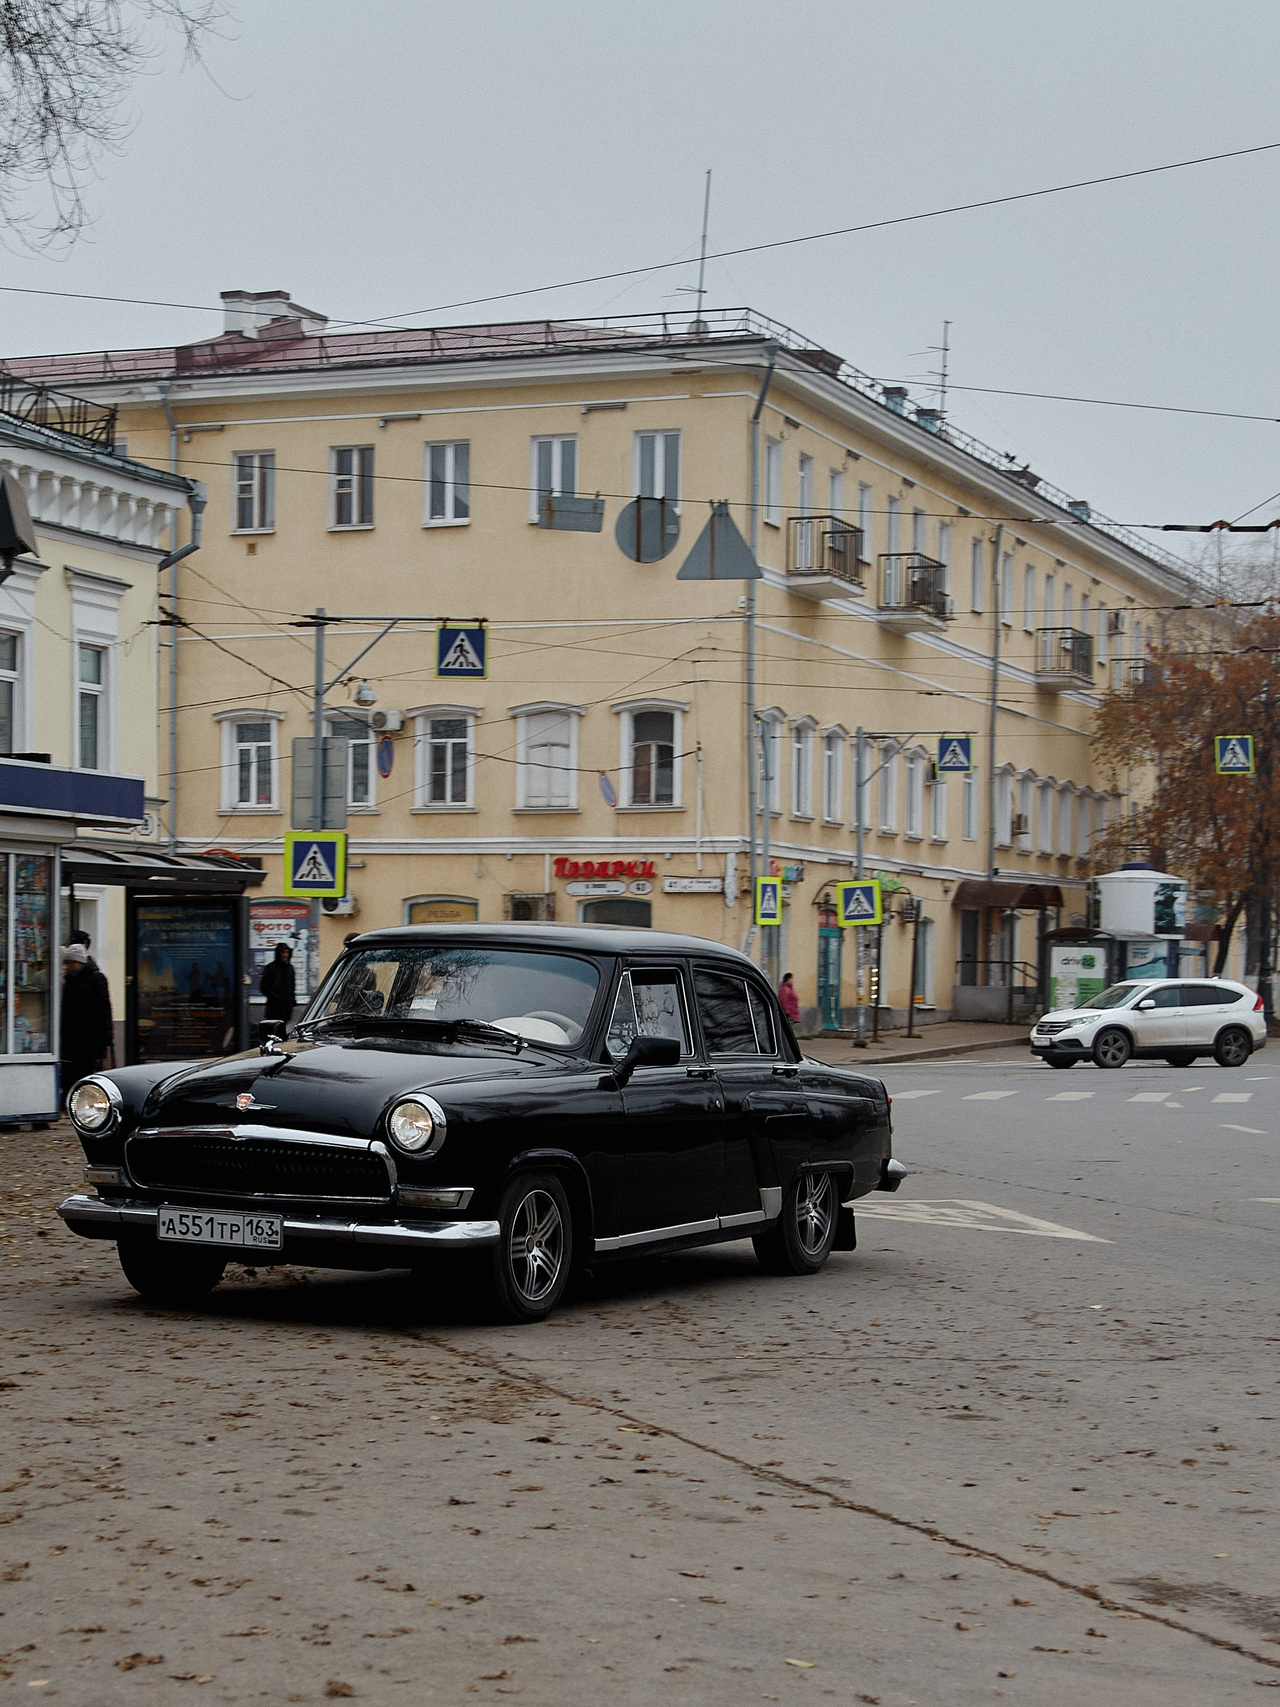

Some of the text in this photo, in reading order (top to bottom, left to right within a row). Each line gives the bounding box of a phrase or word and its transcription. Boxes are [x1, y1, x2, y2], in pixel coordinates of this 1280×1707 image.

[165, 1214, 275, 1240] А551ТР 163
[253, 1236, 268, 1244] RUS
